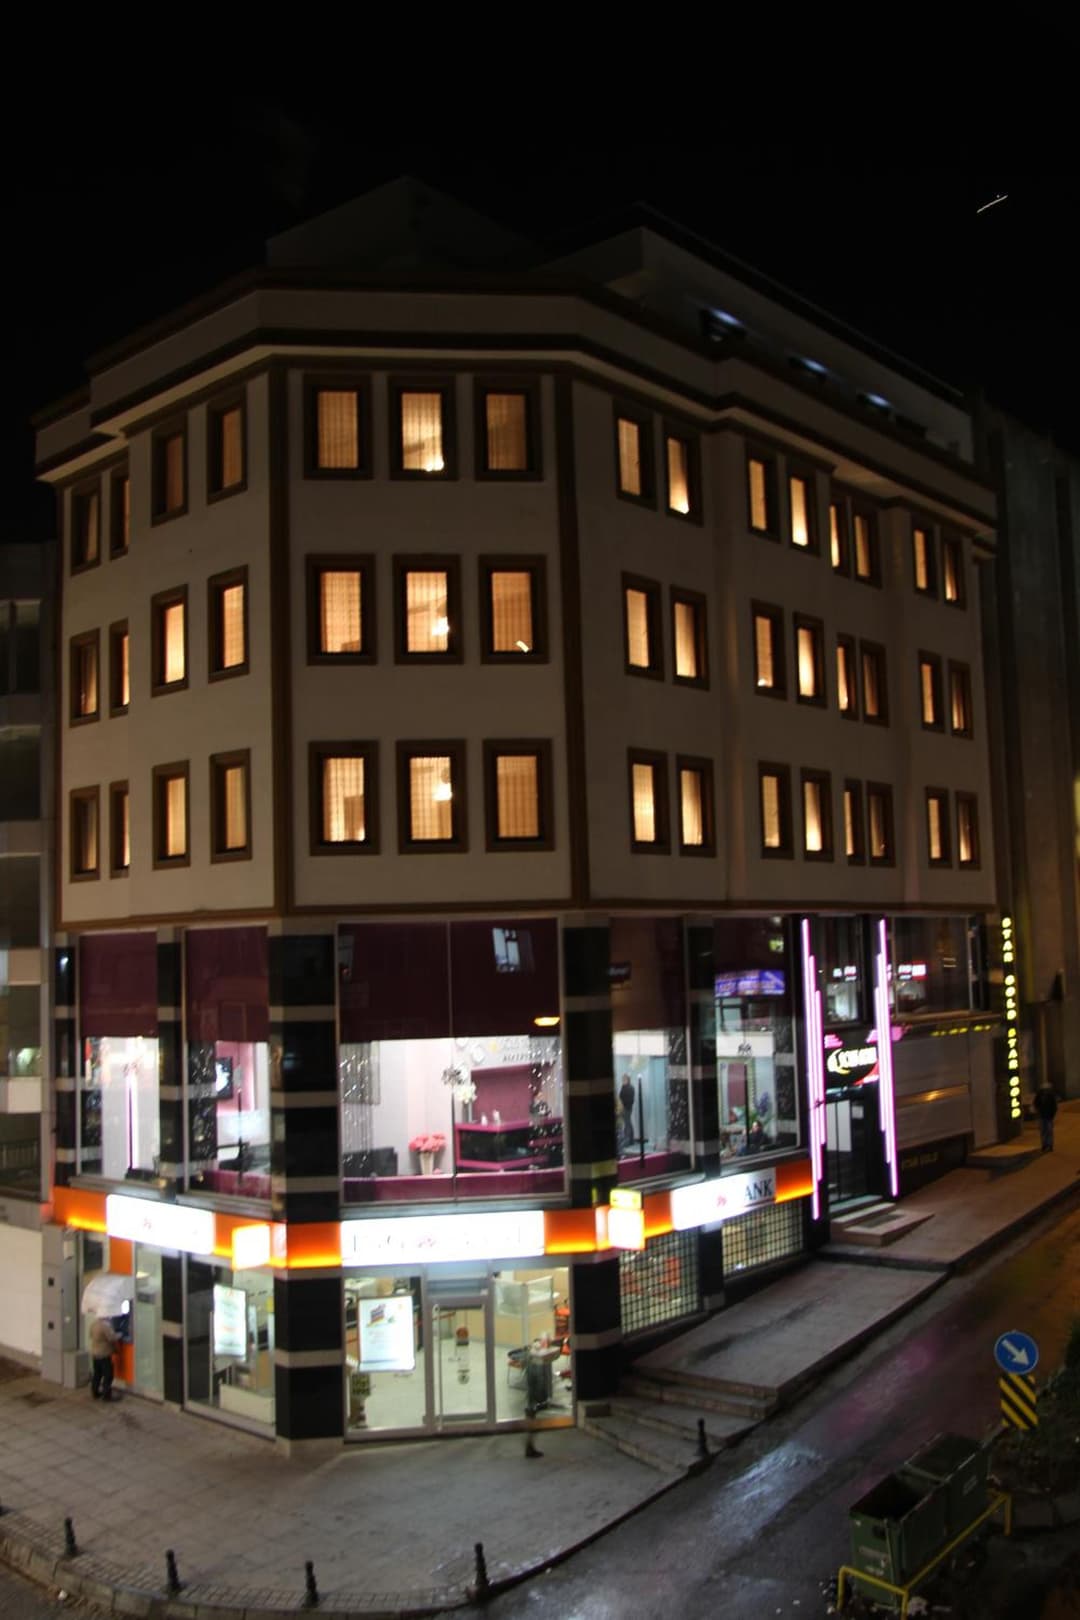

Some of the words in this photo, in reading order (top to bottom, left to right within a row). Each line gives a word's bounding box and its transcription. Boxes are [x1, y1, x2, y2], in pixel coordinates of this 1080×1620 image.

[1001, 916, 1014, 963] STAR
[1004, 974, 1017, 1020] GOLD
[1007, 1027, 1019, 1070] STAR
[1009, 1075, 1021, 1118] GOLD
[744, 1178, 775, 1202] ANK
